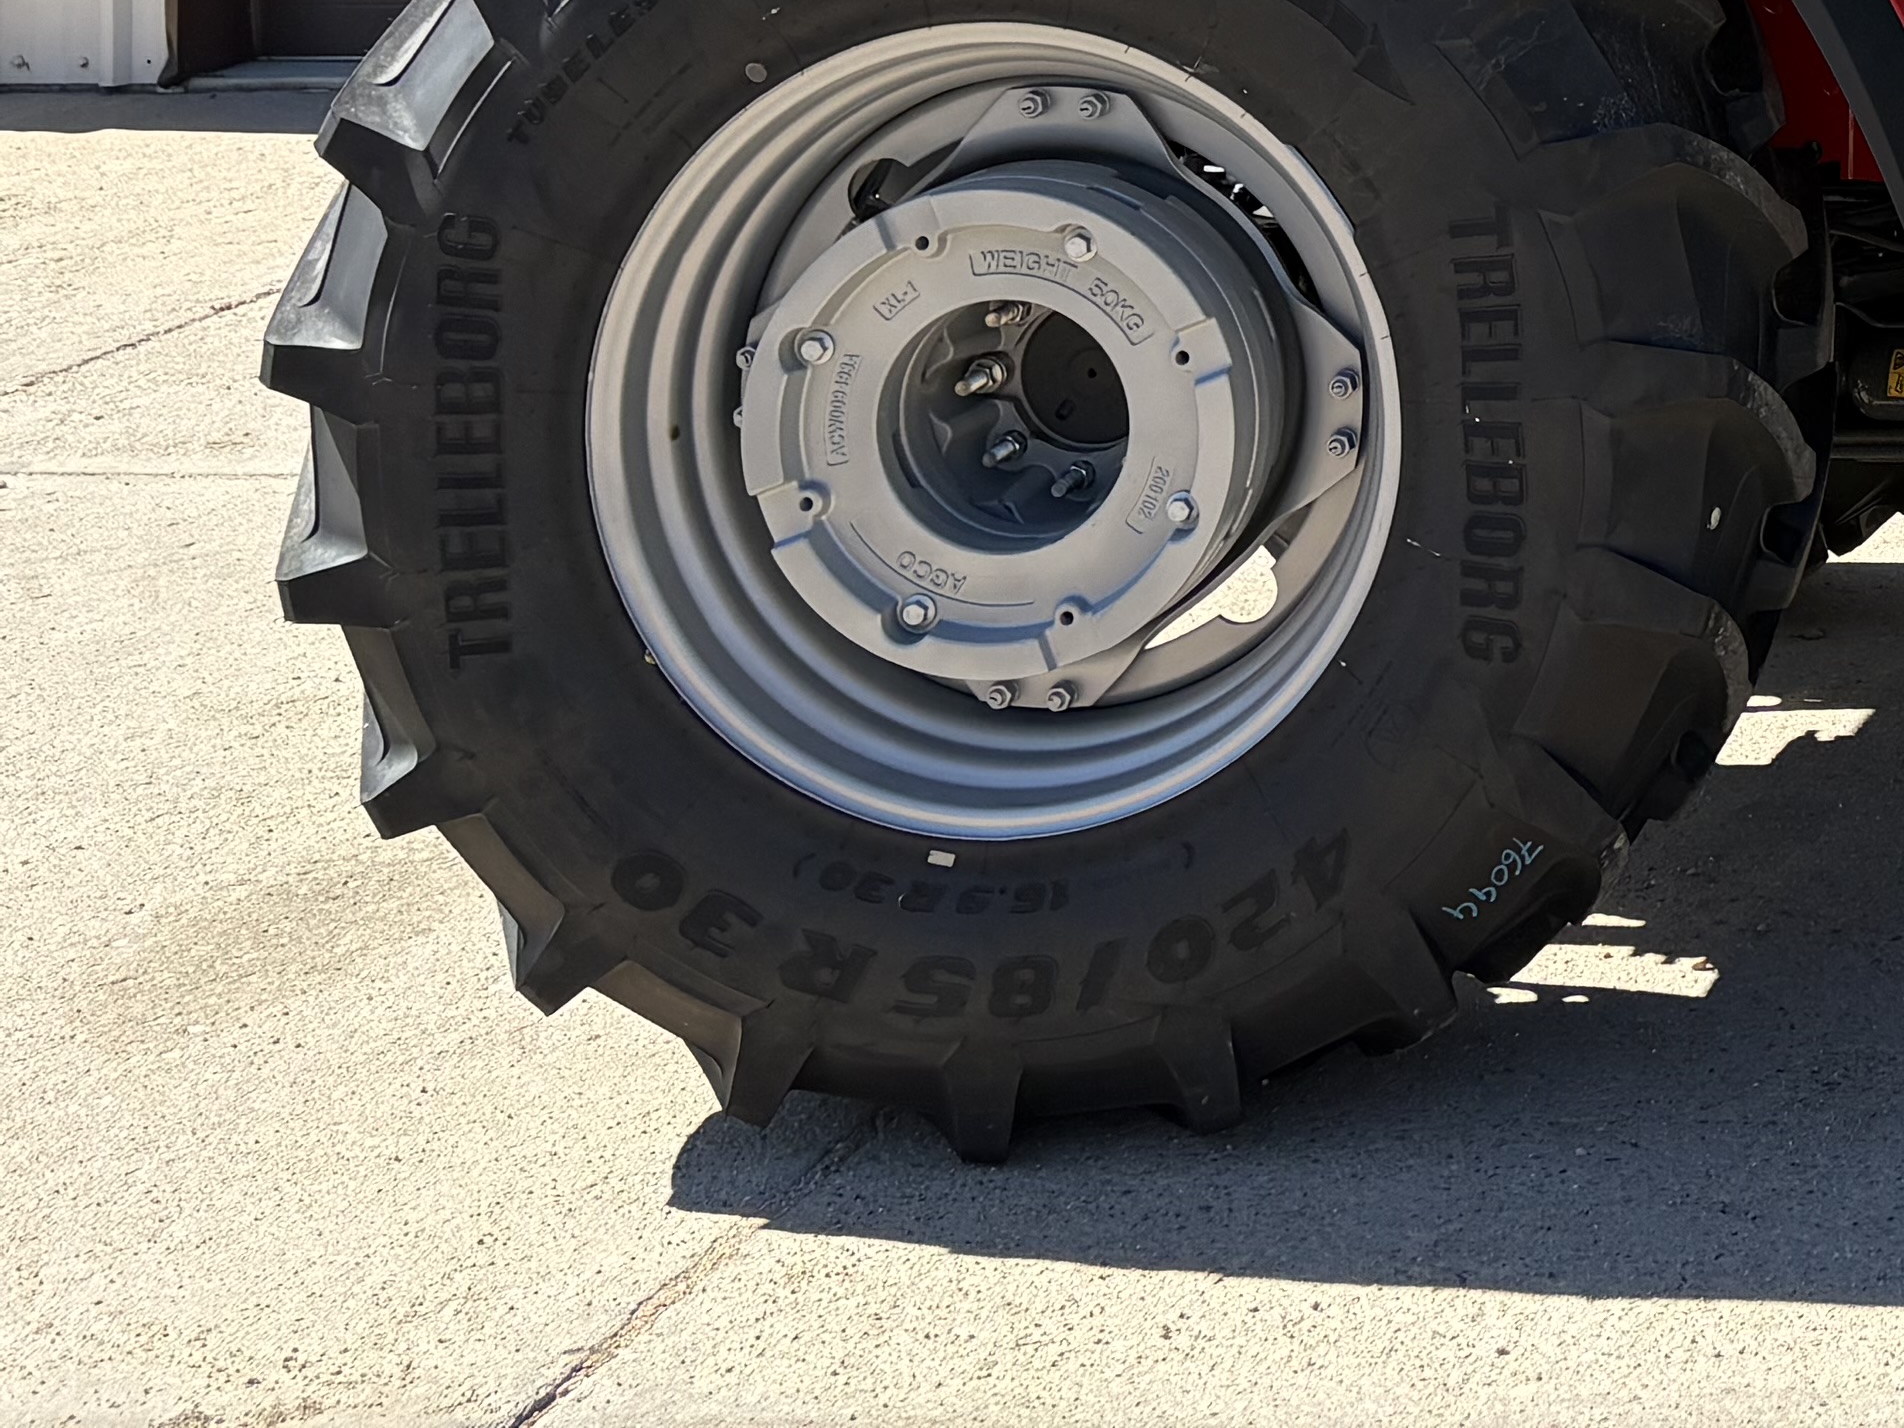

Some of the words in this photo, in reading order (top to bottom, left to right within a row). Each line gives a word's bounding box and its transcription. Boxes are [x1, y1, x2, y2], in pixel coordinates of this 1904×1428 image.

[980, 248, 1079, 282] WEIGHT
[1089, 277, 1146, 334] 50KG
[428, 211, 514, 671] TRELLEBORG
[1447, 203, 1530, 666] TRELLEBORG
[896, 549, 968, 594] AGCO
